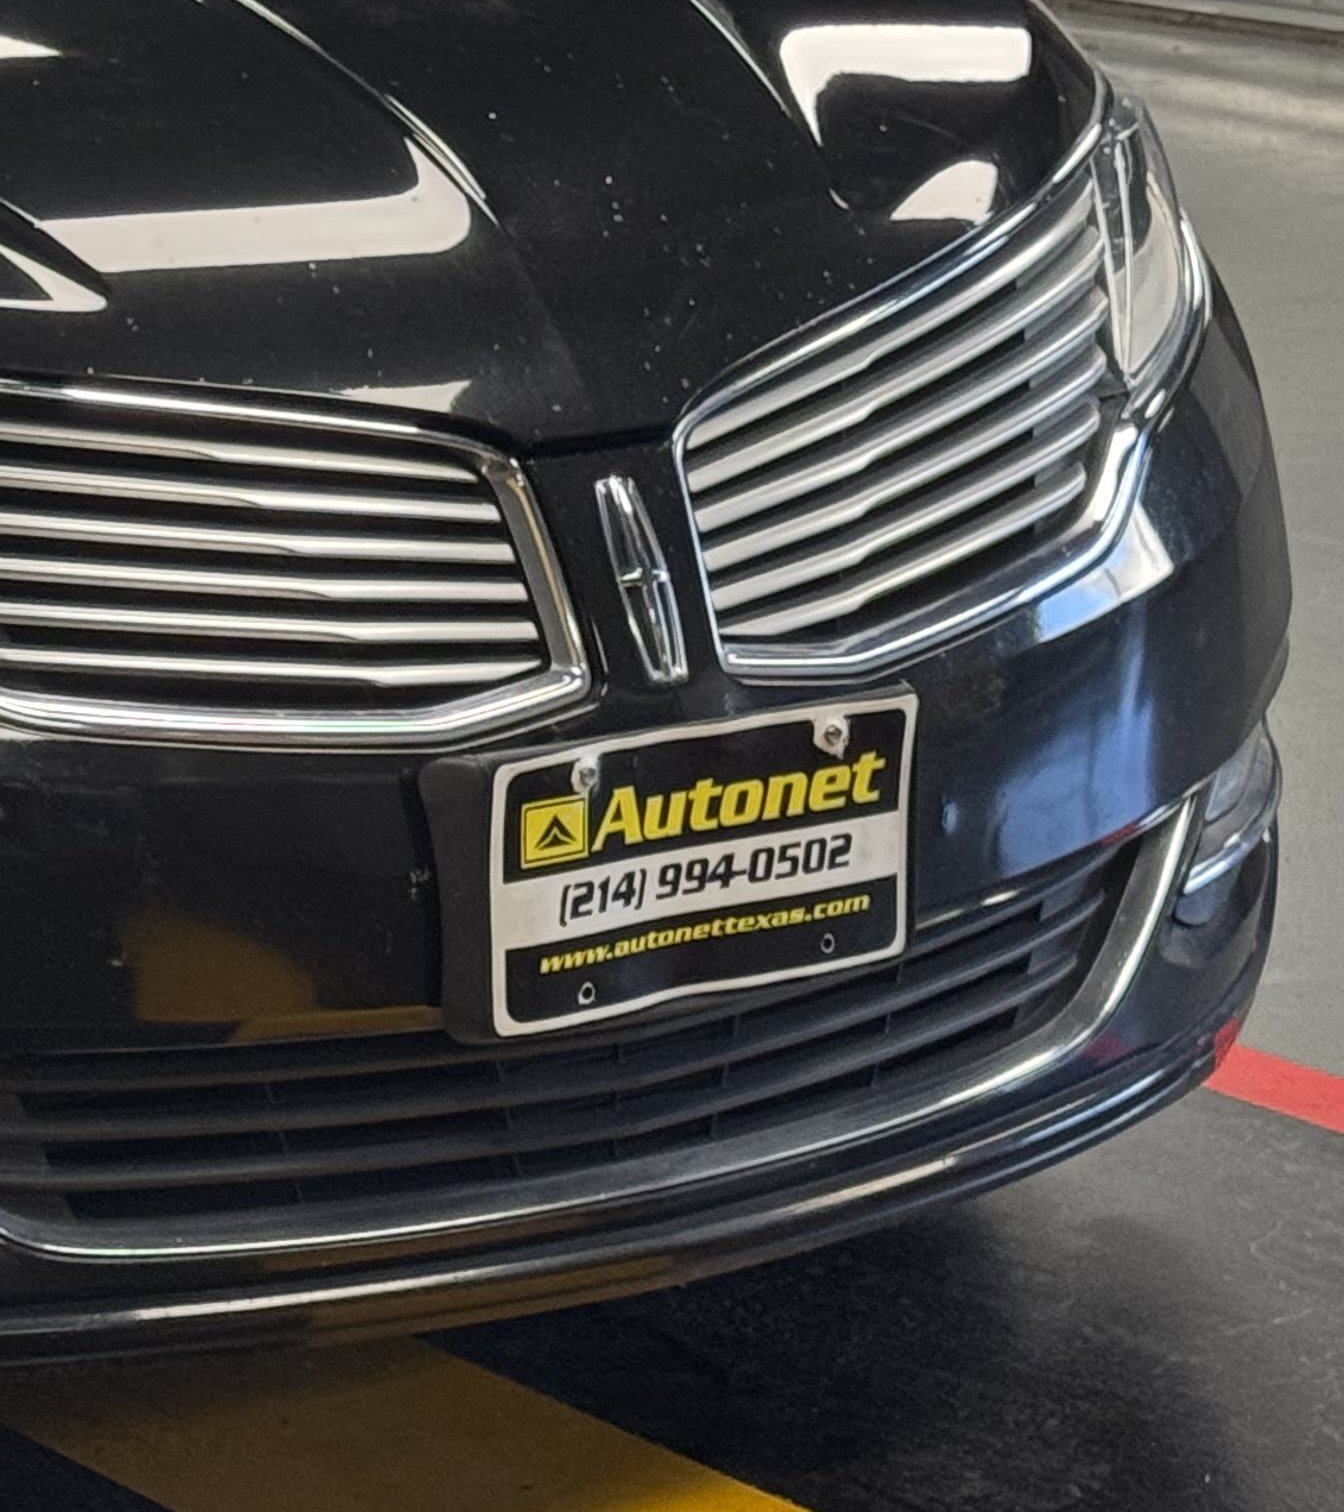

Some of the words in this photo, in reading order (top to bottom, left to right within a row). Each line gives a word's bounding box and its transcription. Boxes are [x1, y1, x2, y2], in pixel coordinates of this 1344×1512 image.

[591, 750, 887, 852] Autonet
[559, 866, 647, 928] (214)
[655, 832, 853, 900] 994-0502
[539, 892, 871, 975] www.autonettexas.com
